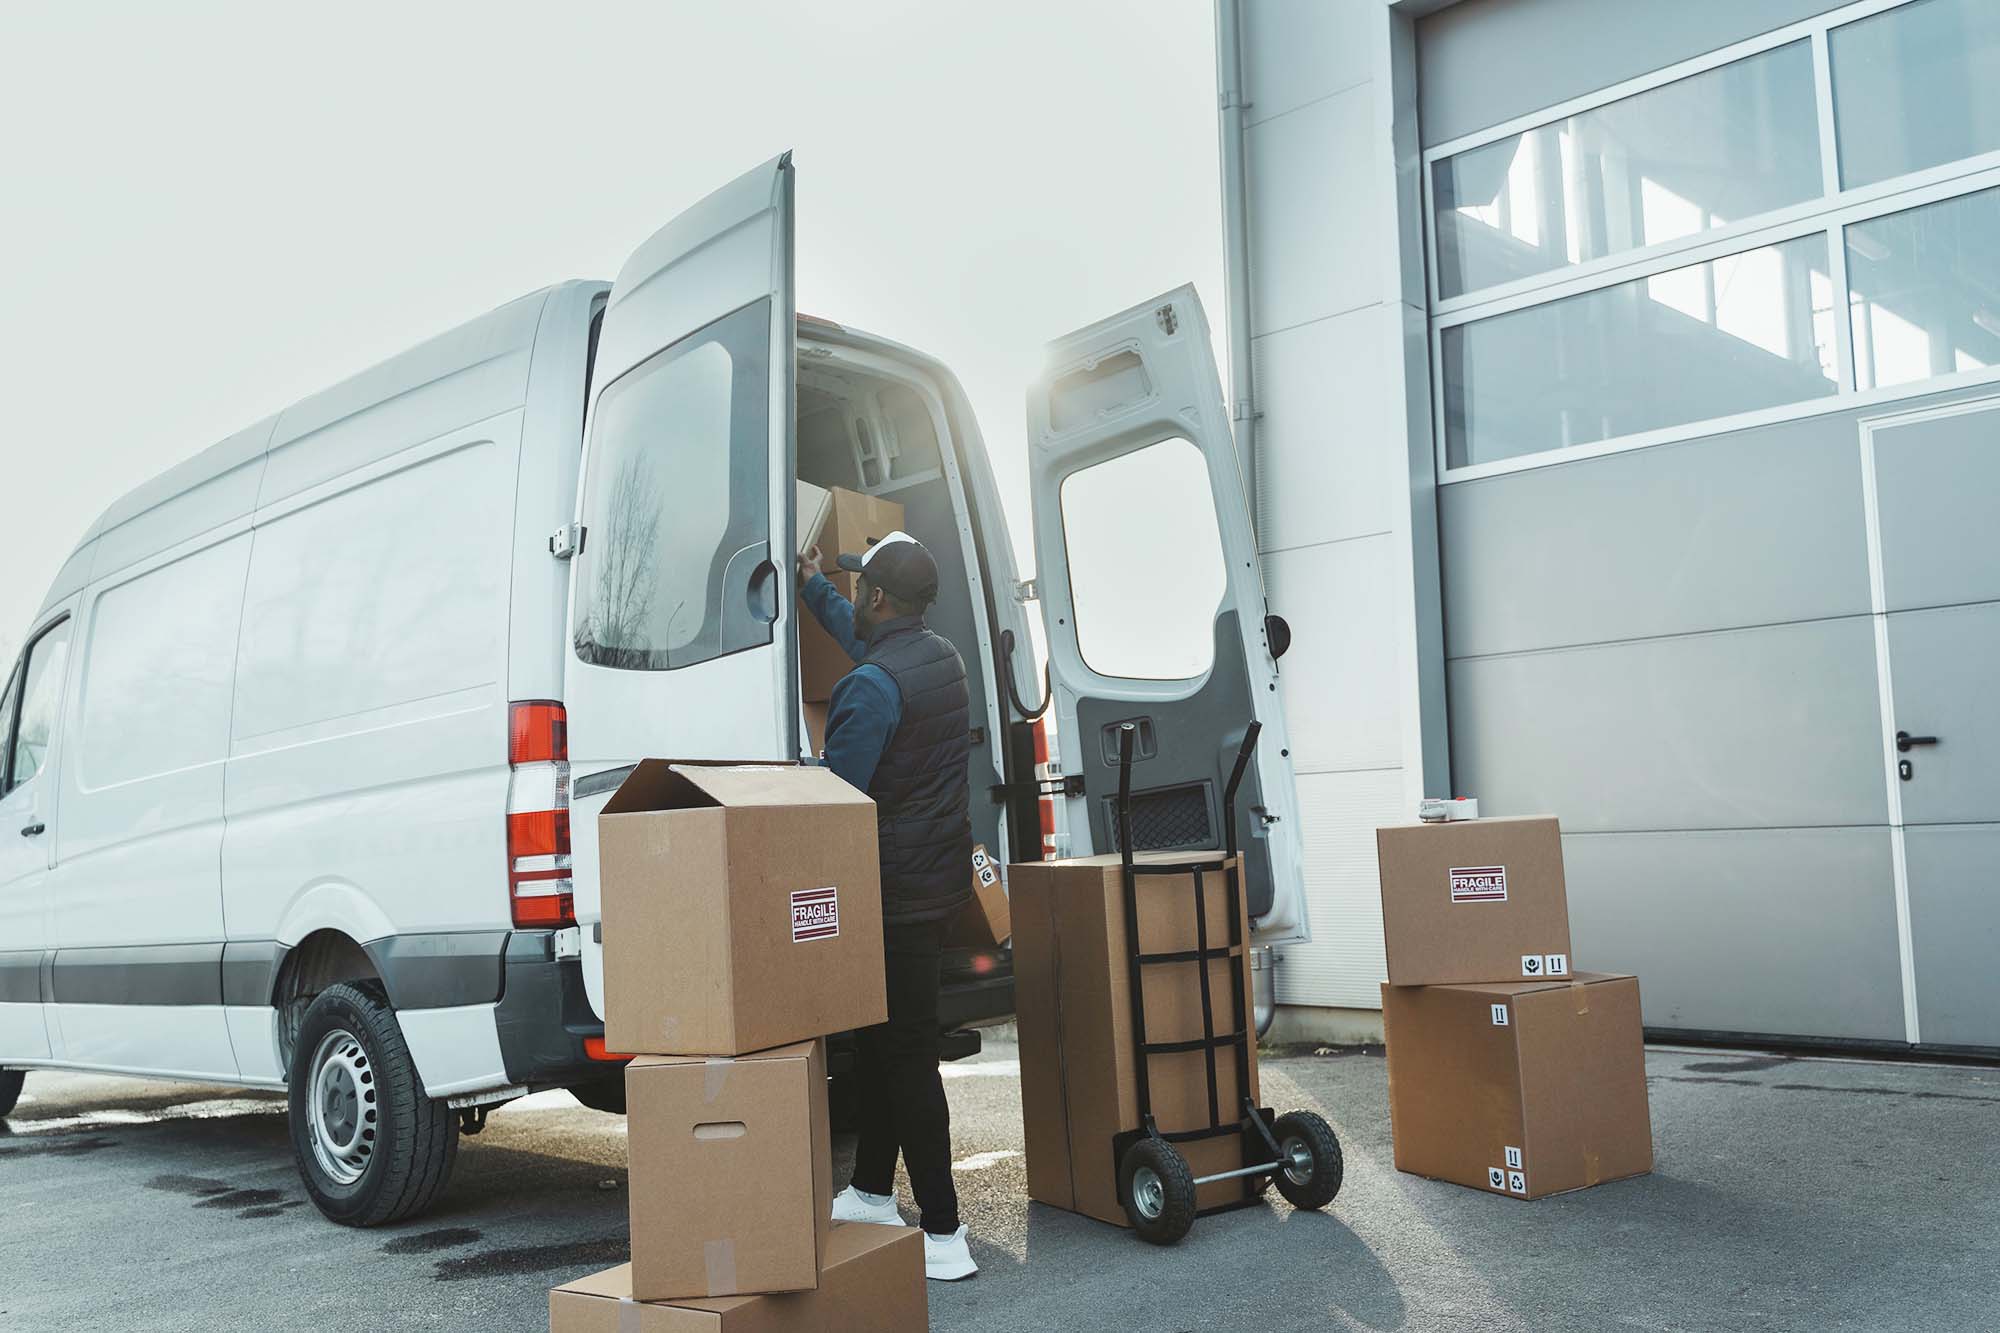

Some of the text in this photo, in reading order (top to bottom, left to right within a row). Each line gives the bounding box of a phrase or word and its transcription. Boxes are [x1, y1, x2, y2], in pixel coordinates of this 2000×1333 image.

[1453, 877, 1502, 888] FRAGILE
[793, 903, 835, 921] FRAGILE
[794, 919, 812, 927] HANDLE
